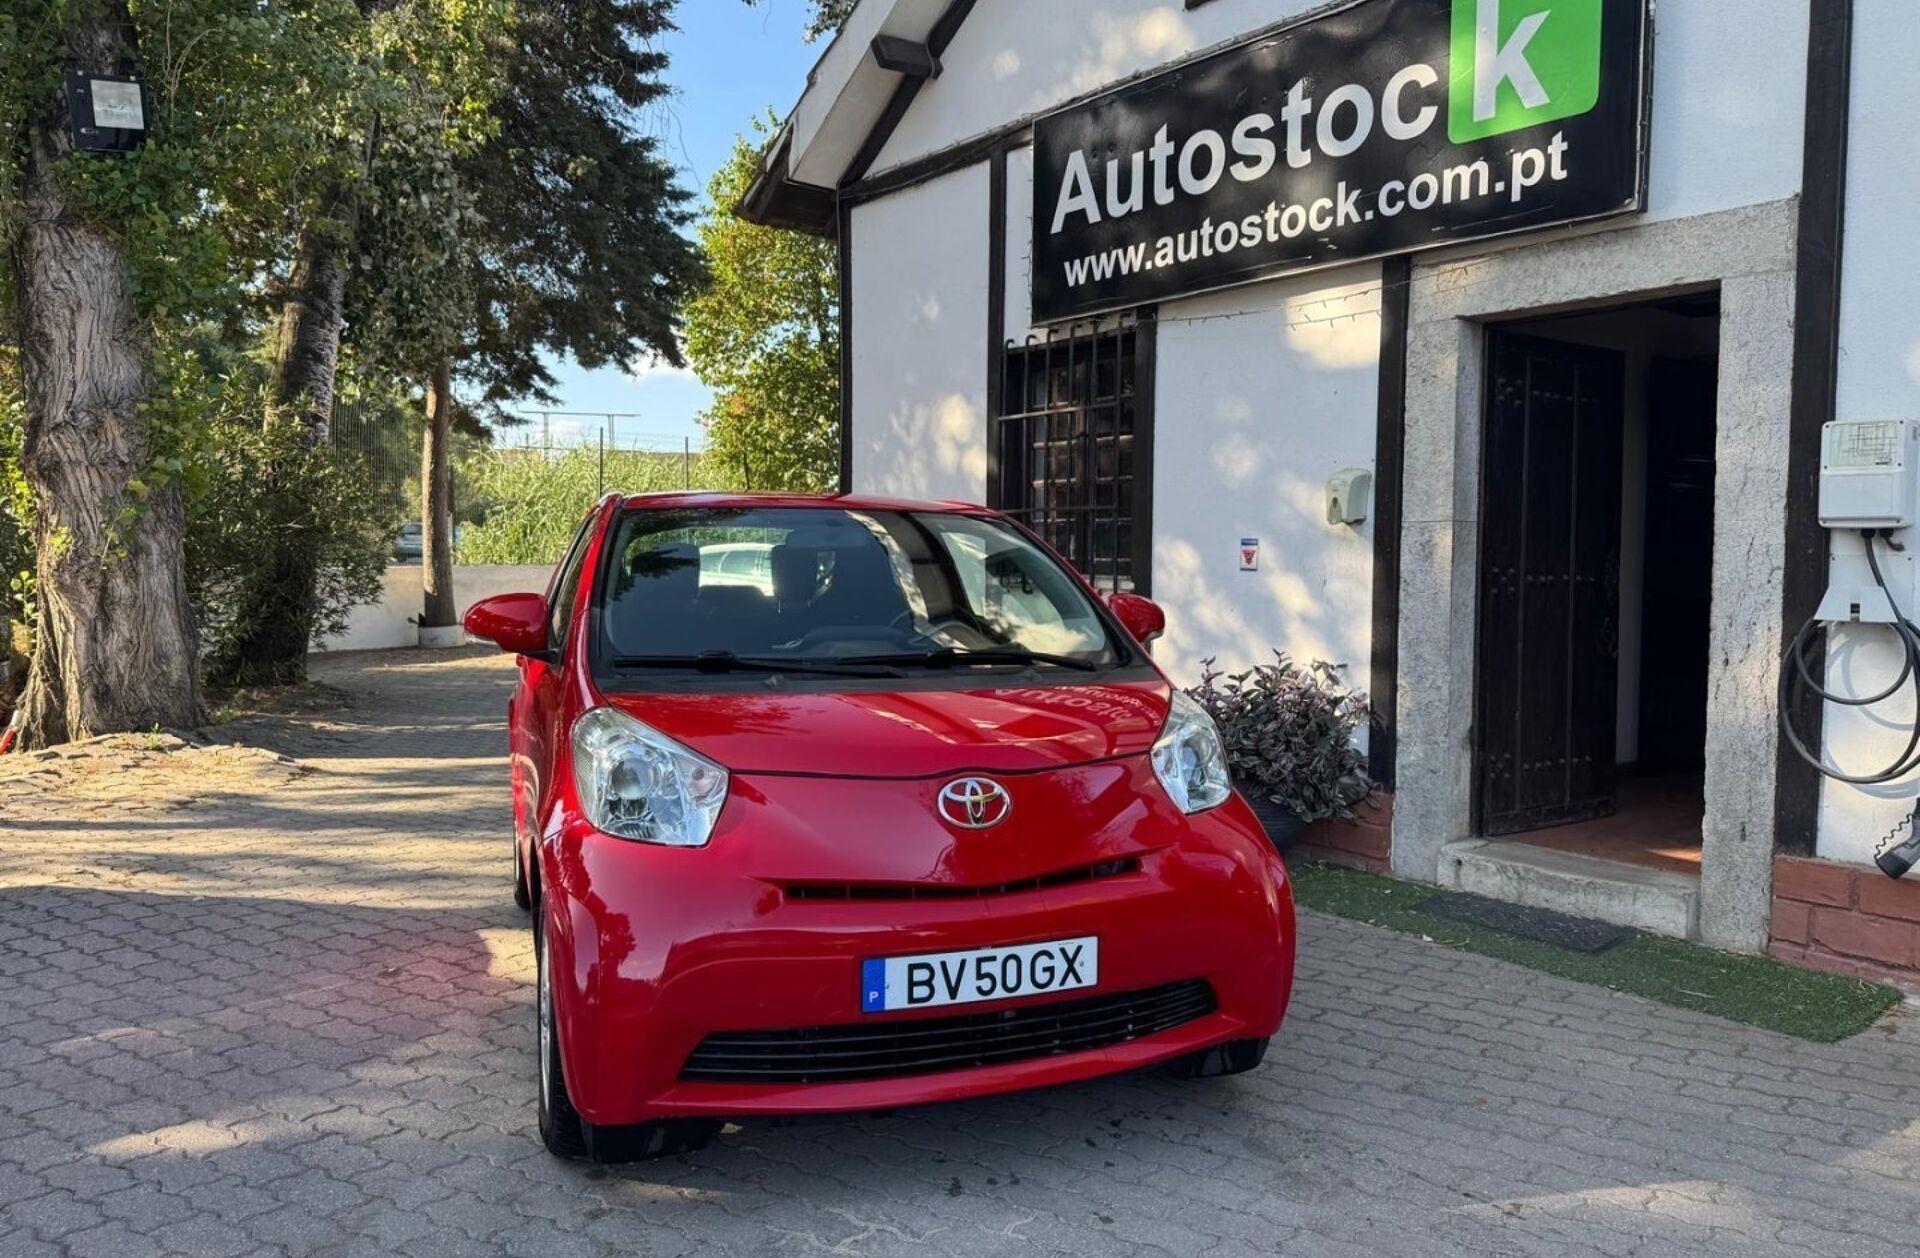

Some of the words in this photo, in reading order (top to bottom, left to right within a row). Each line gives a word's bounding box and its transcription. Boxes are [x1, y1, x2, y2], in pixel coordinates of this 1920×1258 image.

[1050, 0, 1550, 234] Autostock
[1064, 132, 1568, 287] www.autostock.com.pt
[869, 991, 879, 1003] P
